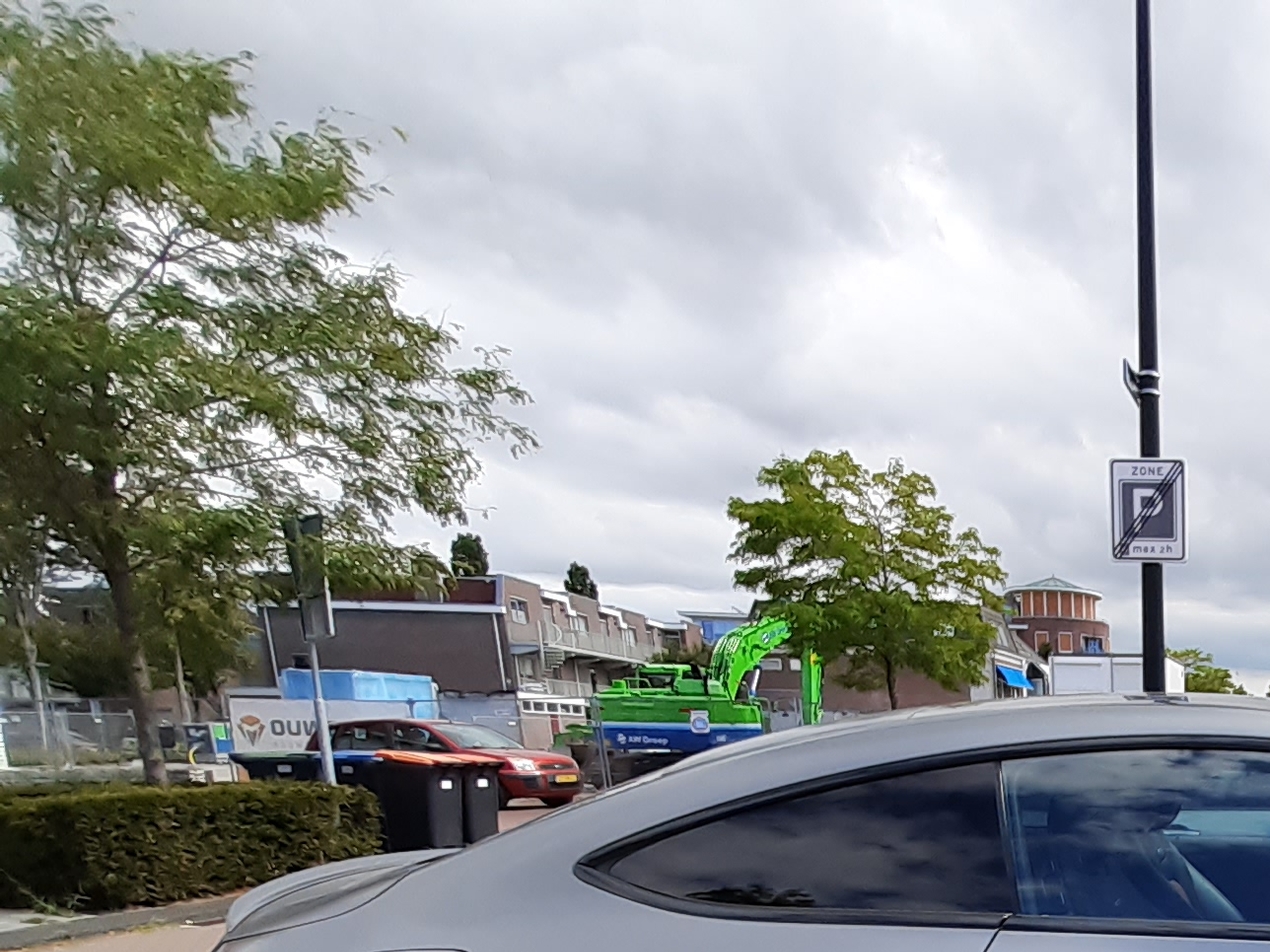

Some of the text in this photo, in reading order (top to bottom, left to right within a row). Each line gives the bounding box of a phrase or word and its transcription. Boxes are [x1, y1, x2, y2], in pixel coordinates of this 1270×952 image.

[1131, 466, 1164, 476] ZONE
[1132, 488, 1164, 533] P
[1132, 543, 1173, 553] max 2h
